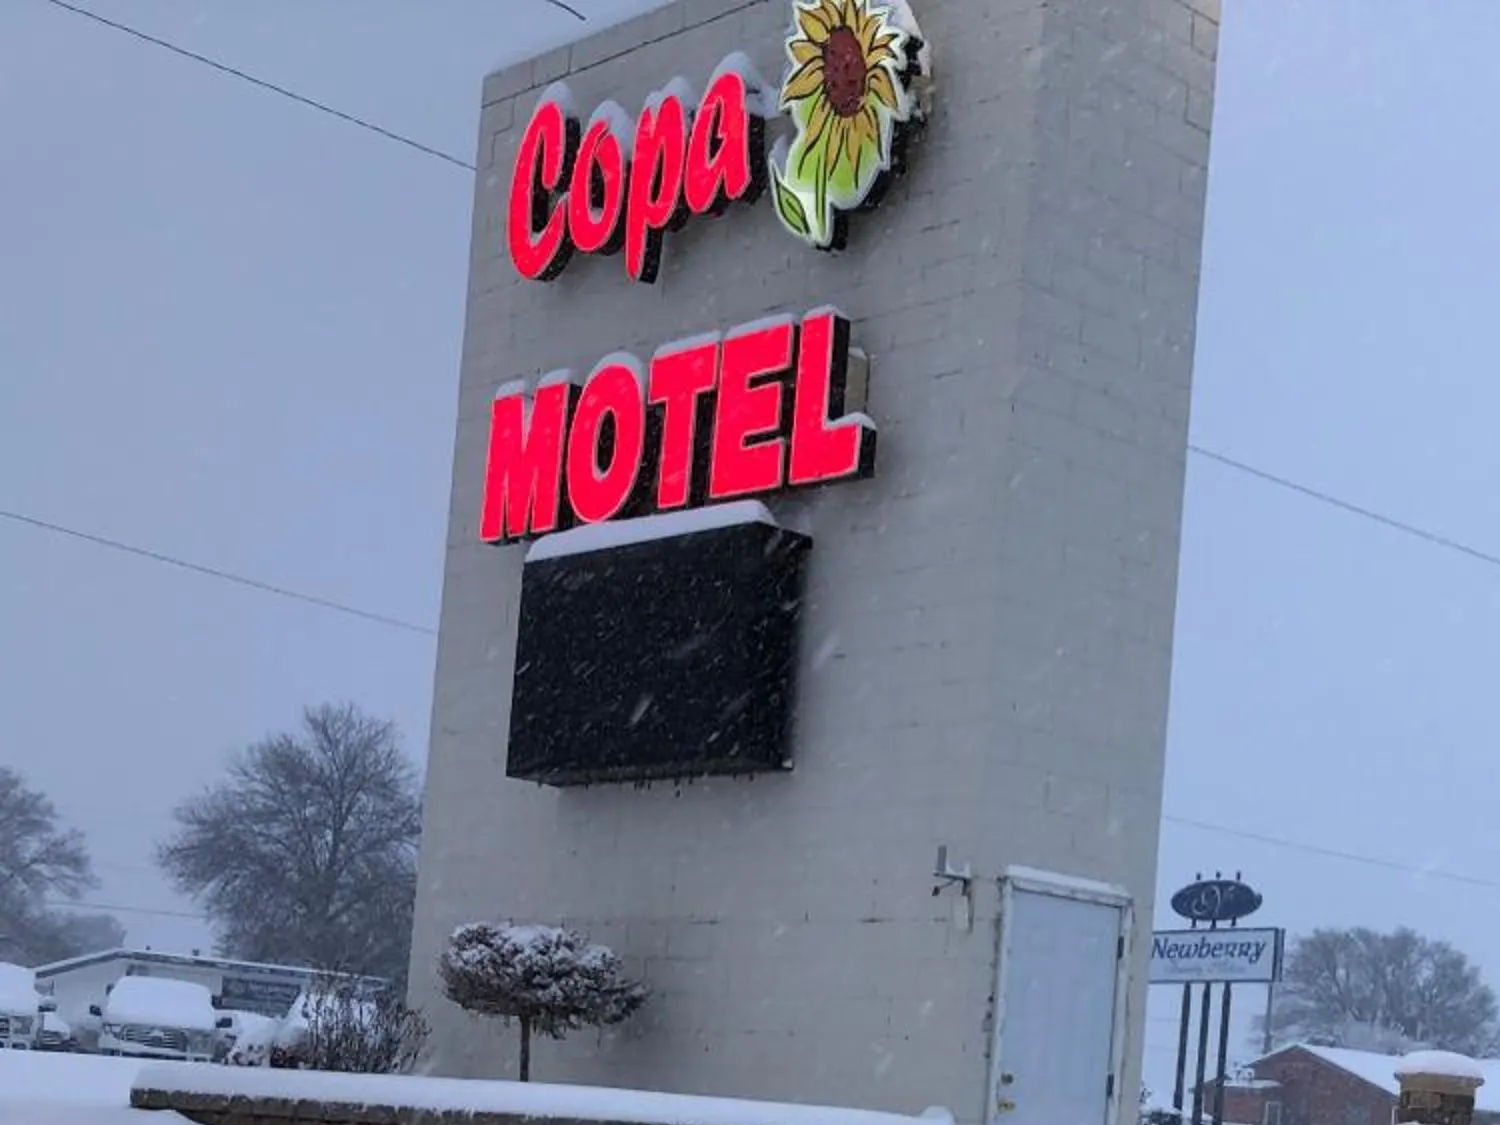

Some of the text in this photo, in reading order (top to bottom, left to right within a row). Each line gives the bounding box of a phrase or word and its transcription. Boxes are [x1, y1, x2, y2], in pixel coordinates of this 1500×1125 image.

[508, 70, 758, 282] Copa
[480, 310, 864, 542] MOTEL
[1151, 936, 1267, 964] Newberry
